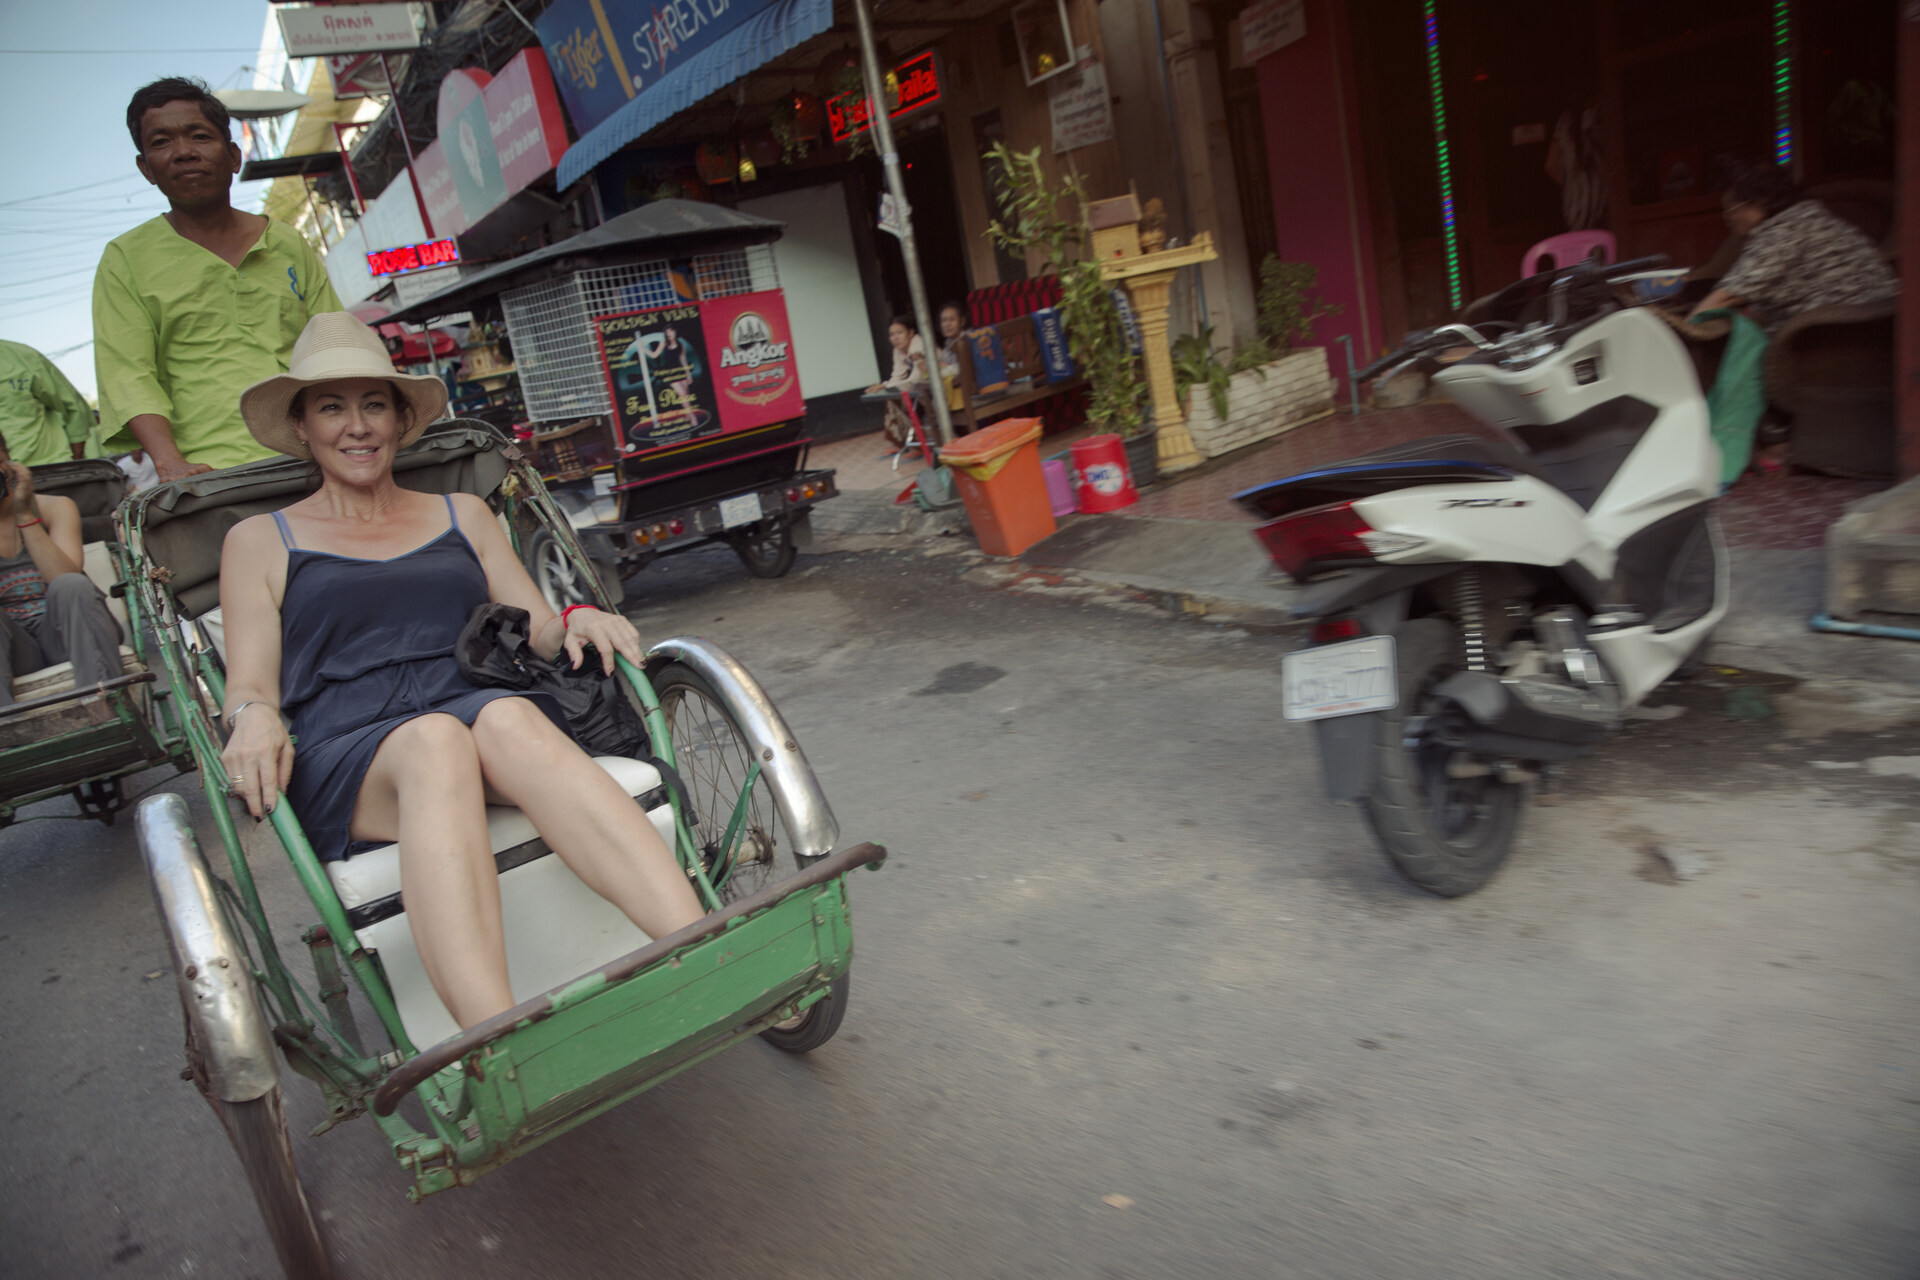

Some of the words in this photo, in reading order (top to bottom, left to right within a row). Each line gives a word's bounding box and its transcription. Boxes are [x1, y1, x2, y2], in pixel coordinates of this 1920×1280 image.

[560, 27, 603, 89] Tiger
[367, 246, 420, 276] ROSE
[417, 240, 457, 266] BAR
[600, 312, 659, 335] GOLDEN
[721, 342, 788, 368] Angkor
